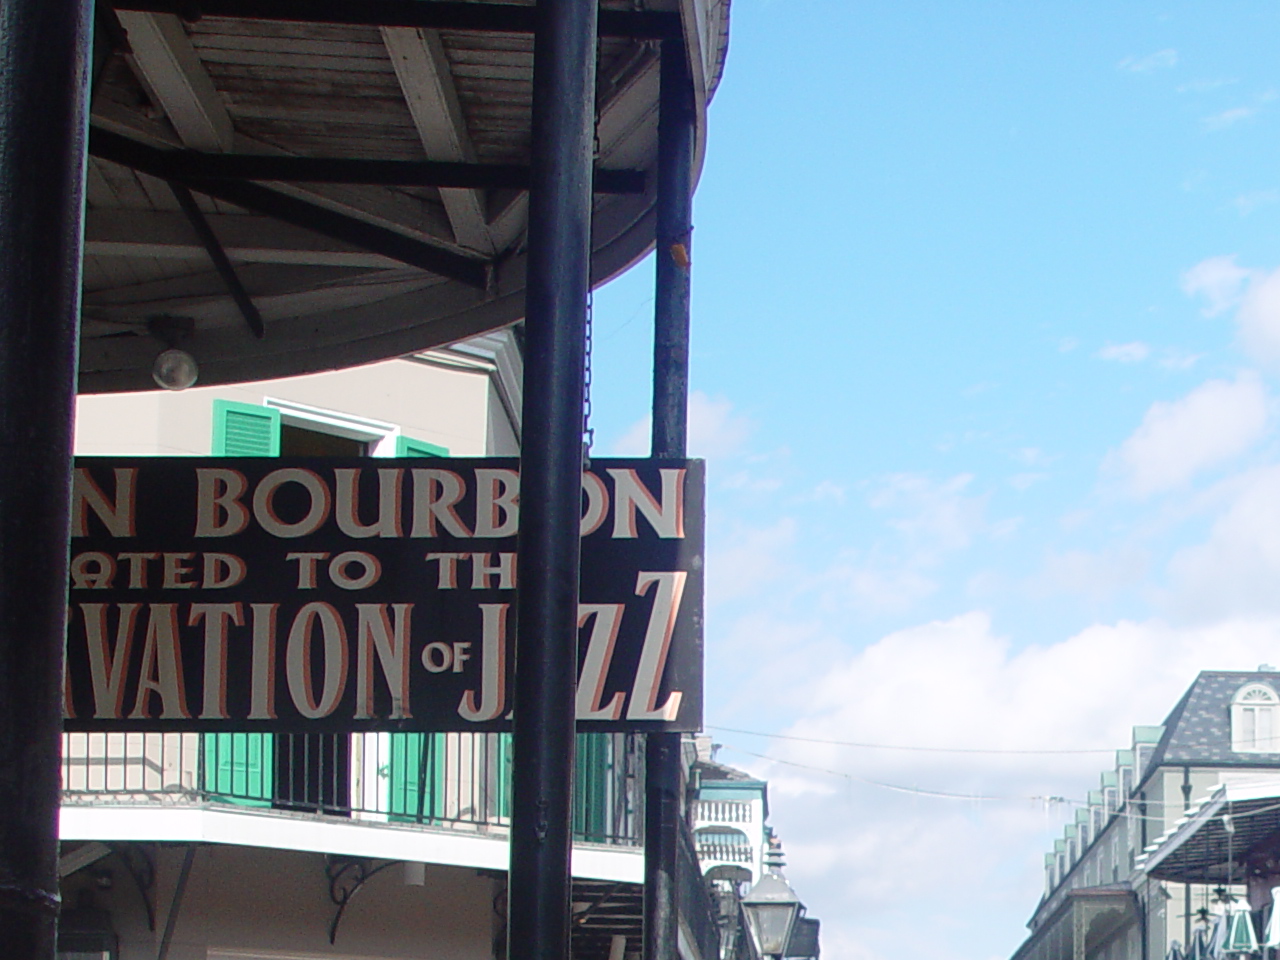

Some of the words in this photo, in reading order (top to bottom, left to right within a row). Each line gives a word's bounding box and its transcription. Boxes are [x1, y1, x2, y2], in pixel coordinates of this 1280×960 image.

[286, 550, 382, 590] TO
[426, 551, 519, 590] TH
[63, 600, 414, 720] VATION
[421, 640, 471, 674] OF
[458, 570, 688, 722] JZZ
